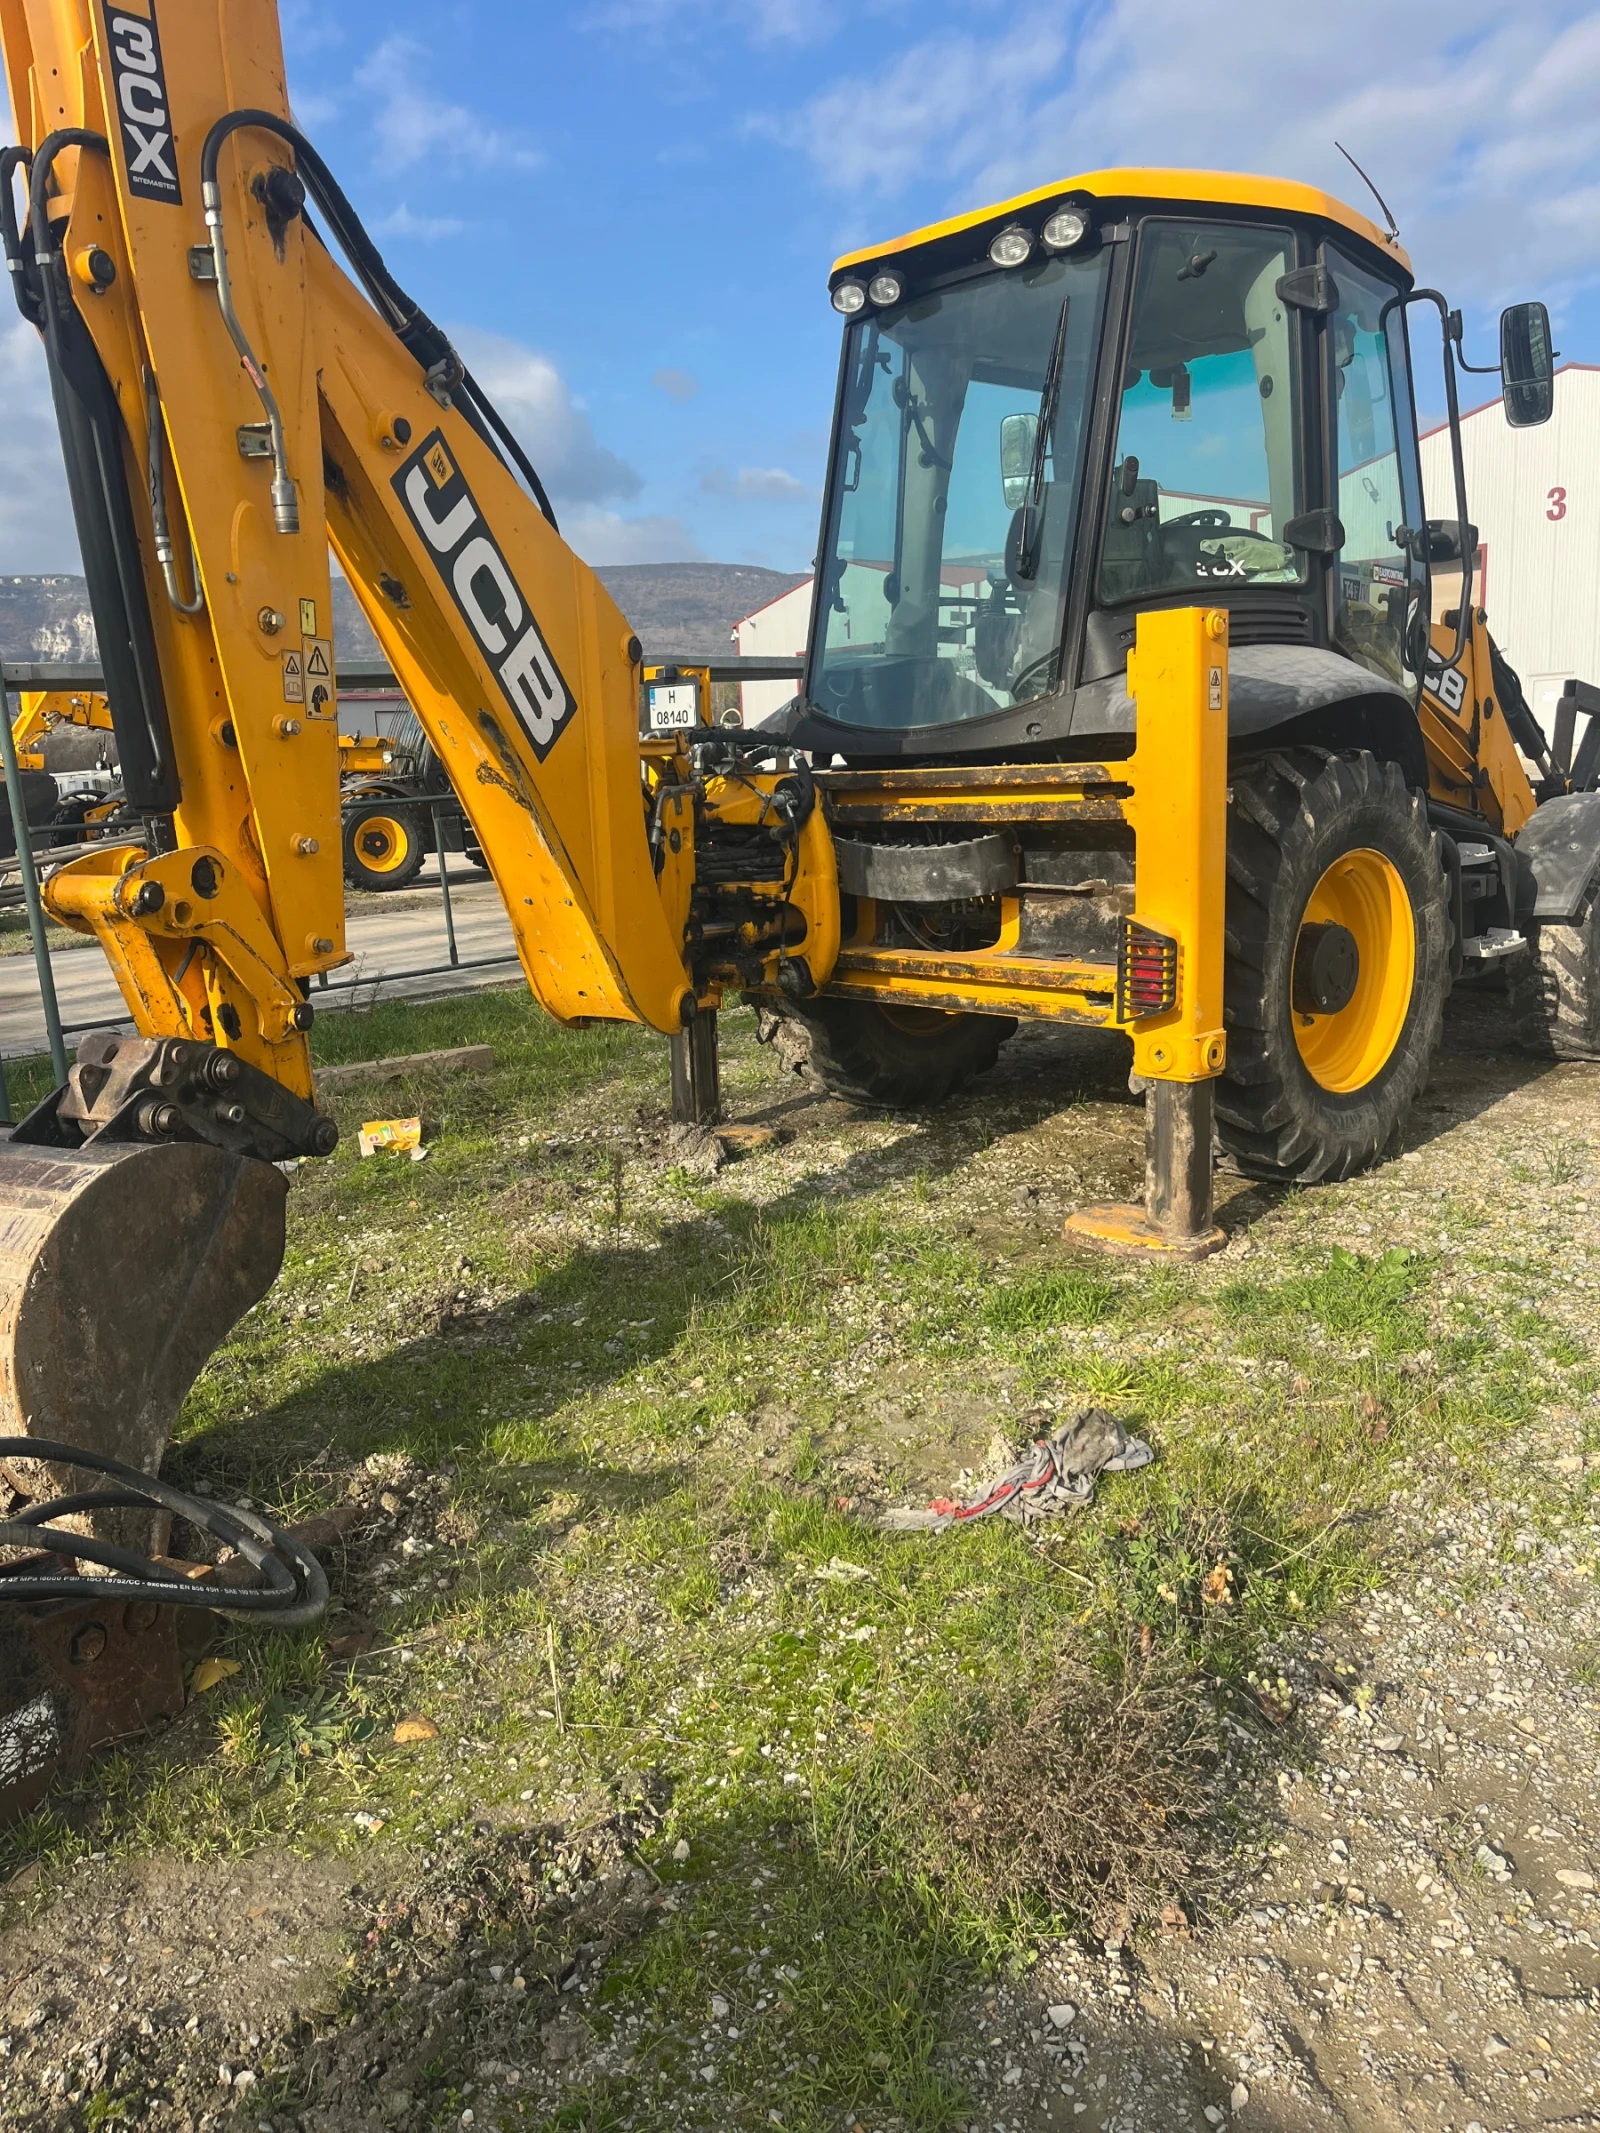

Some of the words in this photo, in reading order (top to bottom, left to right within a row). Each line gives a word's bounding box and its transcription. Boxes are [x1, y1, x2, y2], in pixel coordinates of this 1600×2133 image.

[112, 16, 177, 181] 3CX
[132, 175, 176, 191] SITEMASTER
[432, 452, 447, 478] JCB
[1546, 486, 1567, 522] 3
[405, 464, 567, 746] JCB
[668, 689, 676, 704] H
[656, 709, 689, 725] 08140
